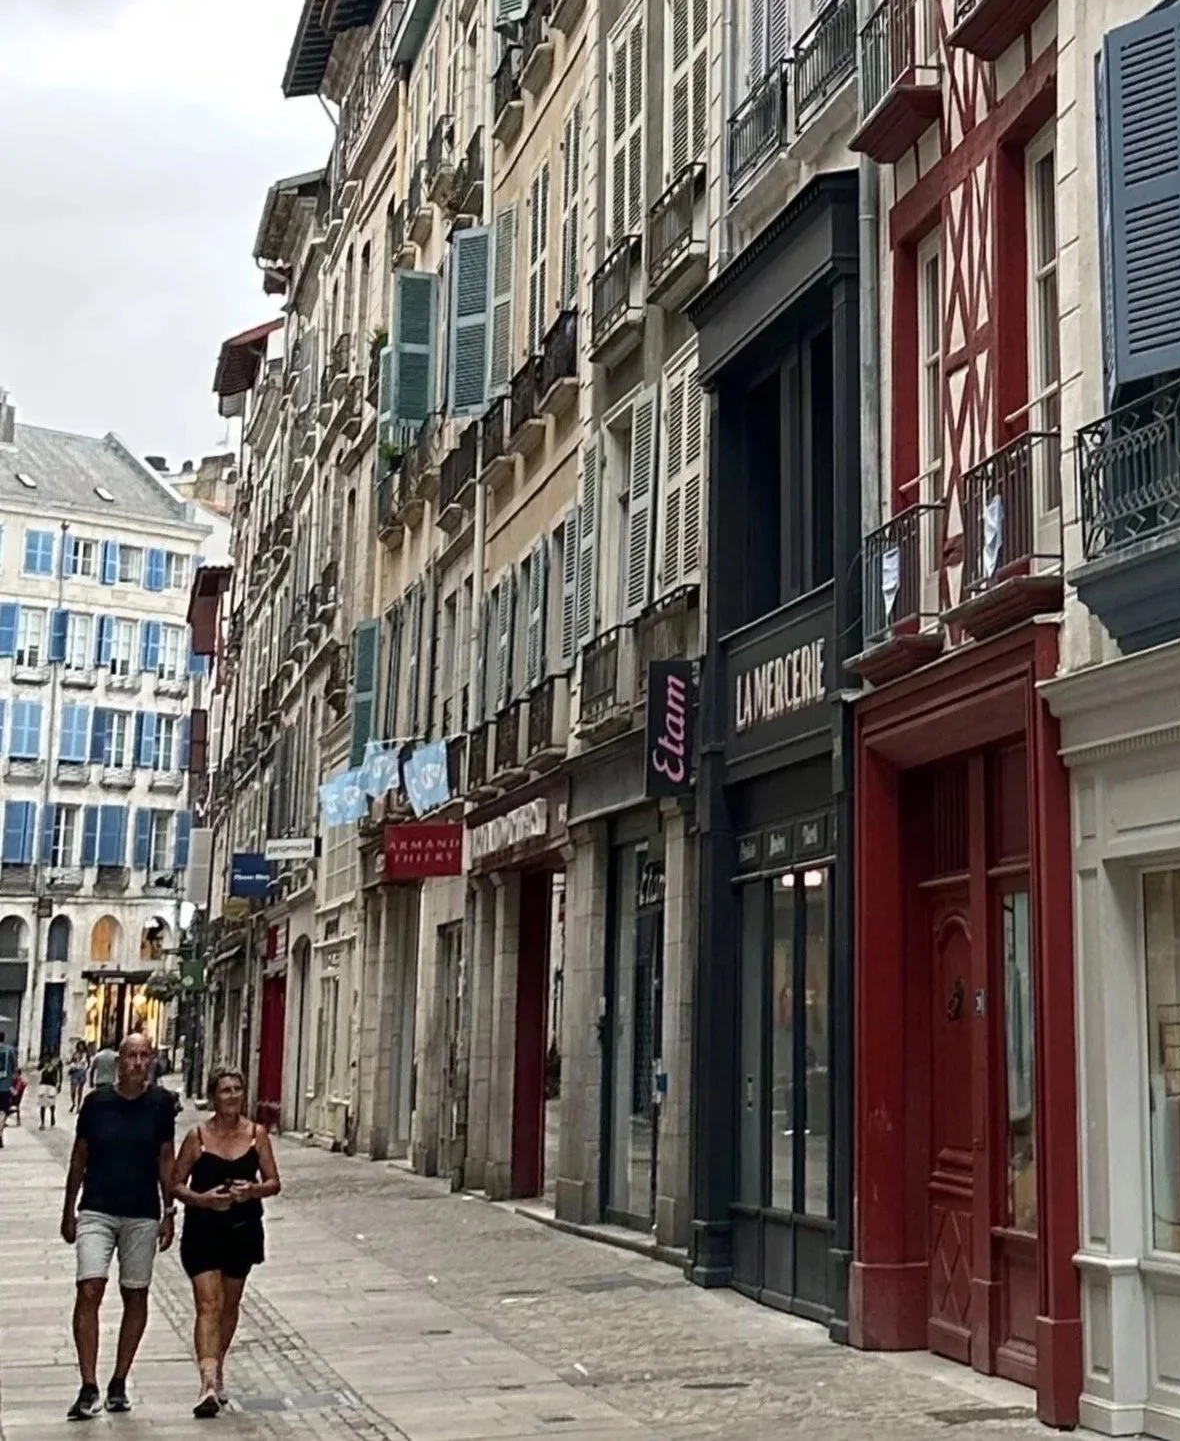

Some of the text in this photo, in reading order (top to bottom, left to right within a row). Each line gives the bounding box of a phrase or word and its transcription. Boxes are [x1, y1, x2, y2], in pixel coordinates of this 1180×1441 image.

[652, 674, 686, 783] Etam
[736, 671, 752, 731] LA
[753, 638, 826, 721] MERCERIE
[389, 839, 460, 851] ARMAND
